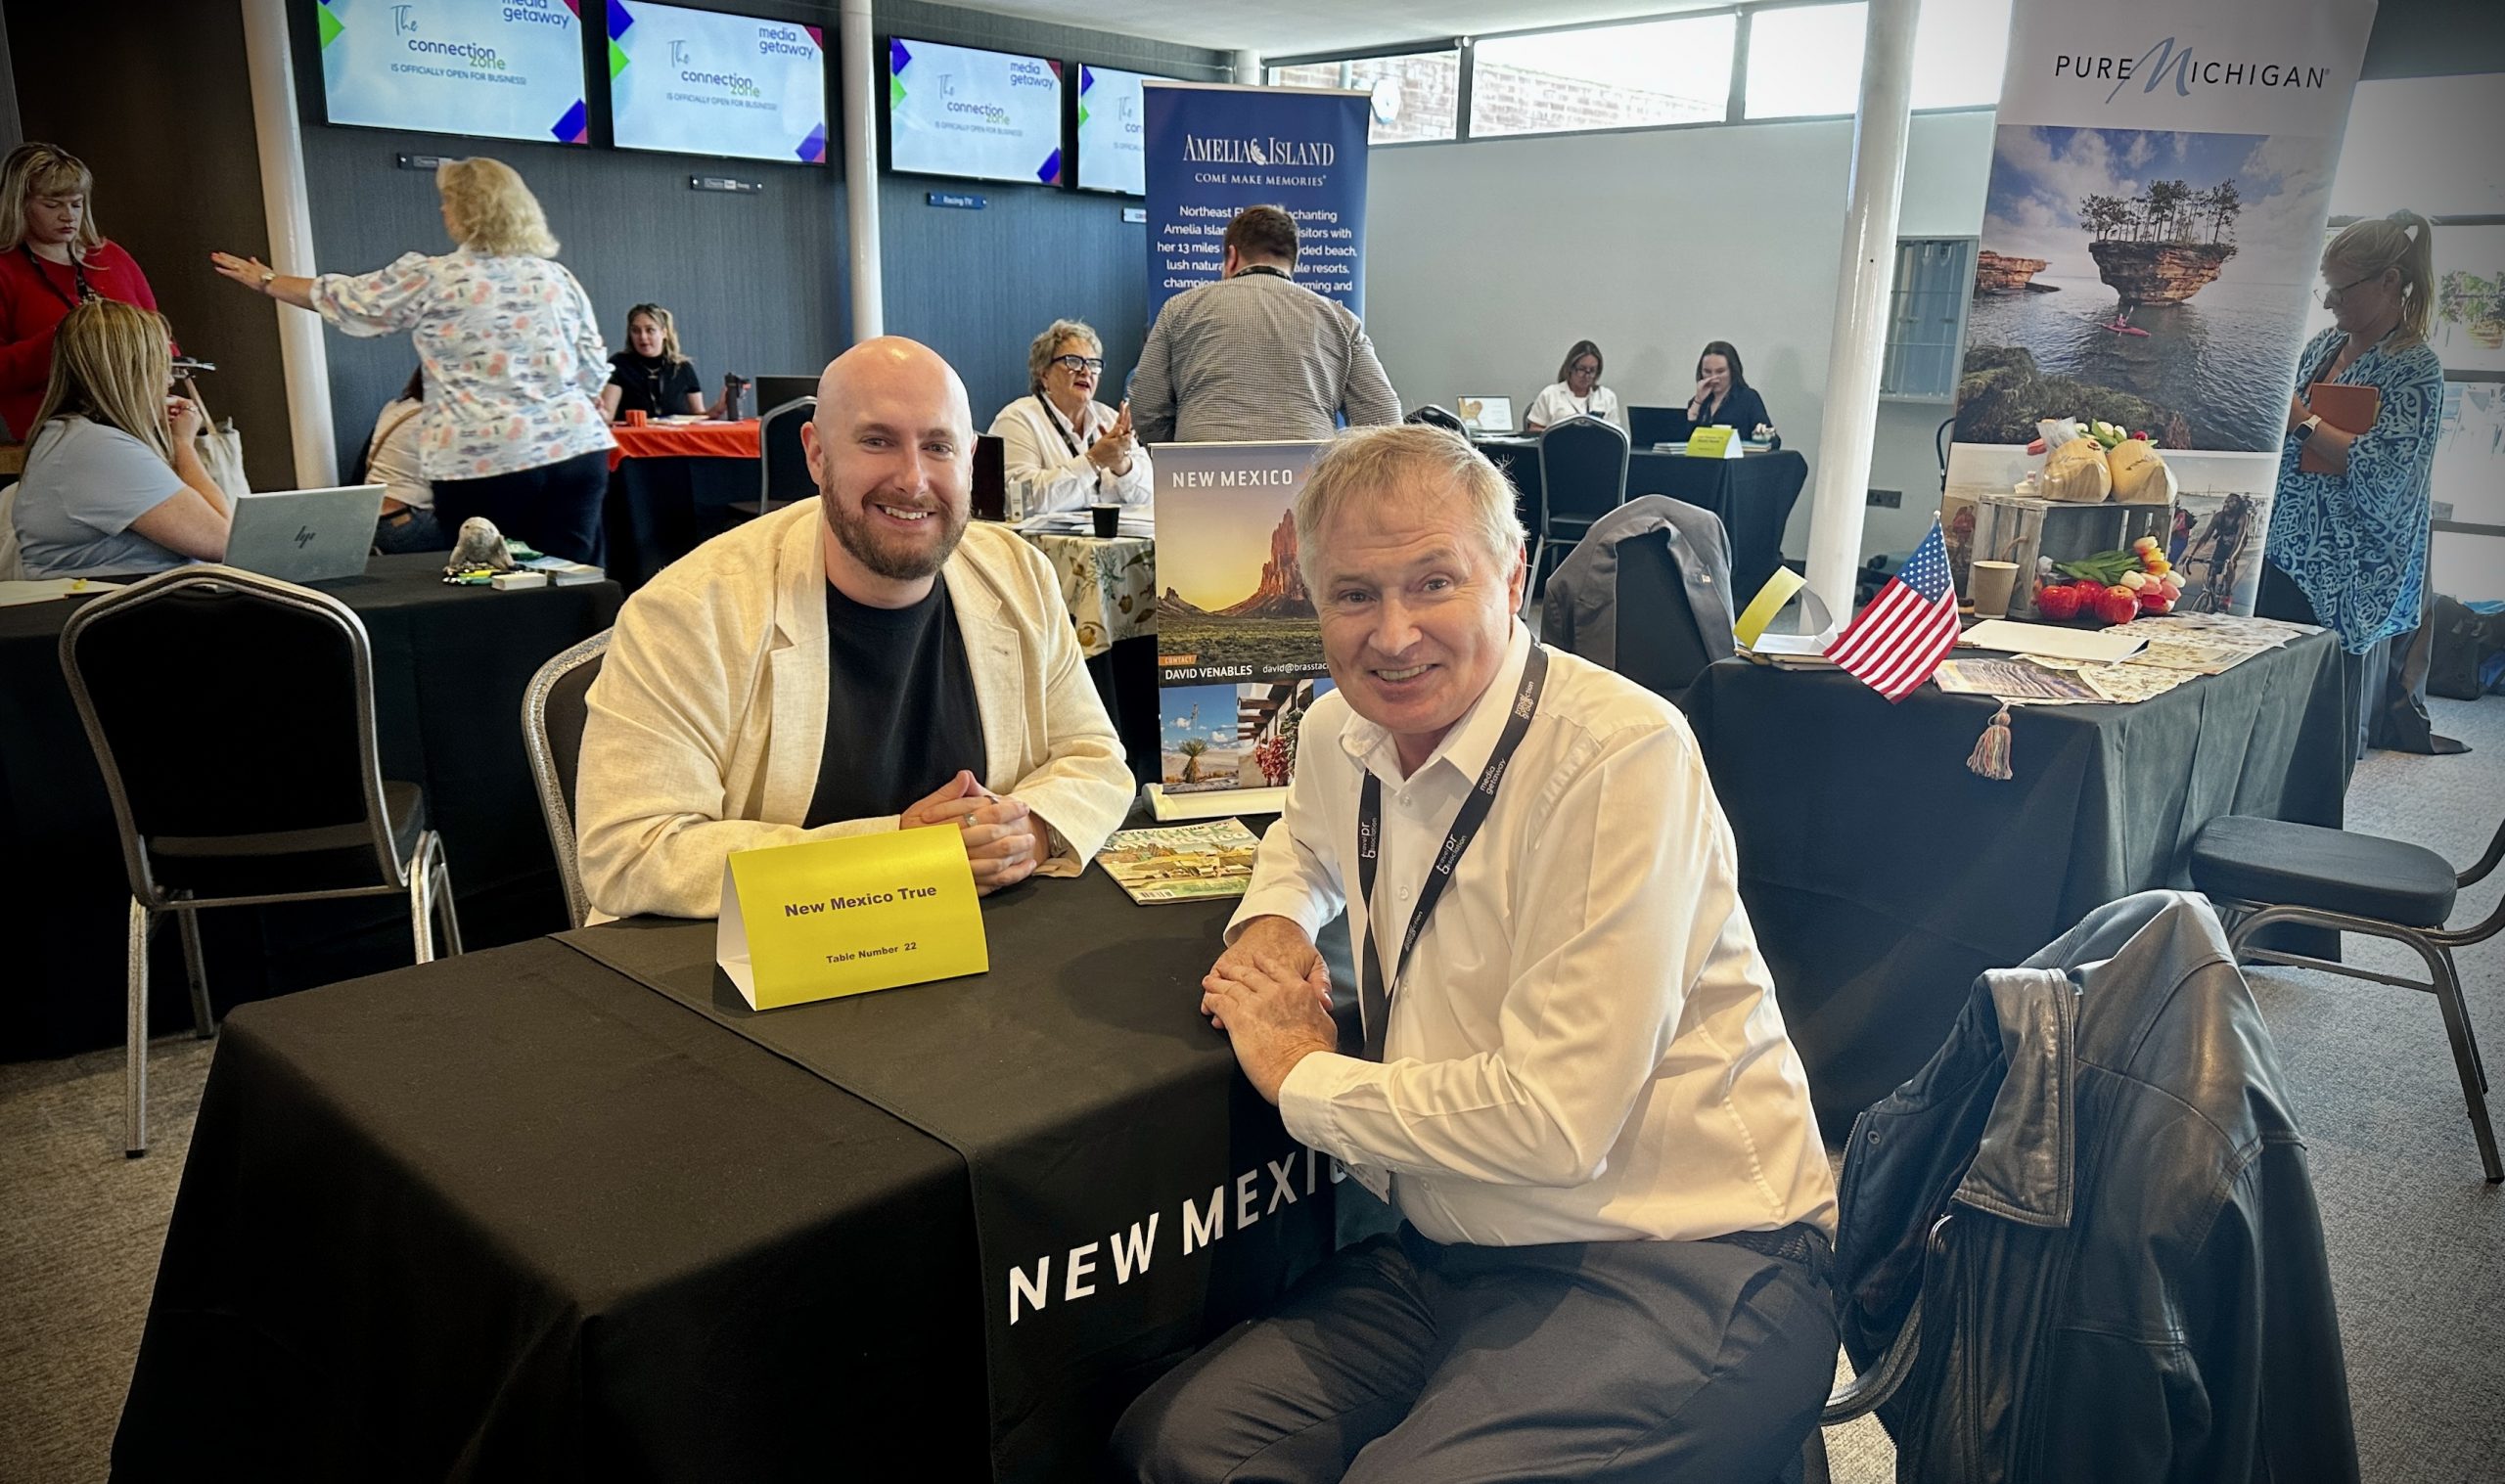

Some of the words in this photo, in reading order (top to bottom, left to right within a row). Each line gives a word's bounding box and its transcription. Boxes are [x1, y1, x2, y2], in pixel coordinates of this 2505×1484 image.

[391, 5, 419, 35] The
[503, 8, 569, 29] getaway
[758, 27, 797, 42] media
[408, 39, 496, 61] connection
[759, 40, 814, 60] getaway
[469, 57, 507, 69] zone
[1010, 62, 1040, 75] media
[2055, 55, 2133, 79] PURE
[2106, 37, 2325, 104] MICHIGAN
[400, 65, 444, 77] OFFICIALLY
[446, 69, 469, 79] OPEN
[471, 72, 486, 81] FOR
[681, 69, 752, 90] connection
[1010, 73, 1054, 91] getaway
[731, 86, 760, 99] zone
[946, 102, 1004, 117] connection
[1183, 134, 1252, 163] AMELIA
[1268, 137, 1334, 166] ISLAND
[1195, 173, 1226, 184] COME
[1231, 175, 1261, 185] MAKE
[1265, 176, 1323, 188] MEMORIES
[1179, 205, 1231, 219] Northeast
[1164, 224, 1200, 236] Amelia
[1204, 224, 1227, 236] Islan
[1297, 228, 1328, 239] isitors
[1330, 227, 1351, 239] with
[1157, 242, 1174, 253] her
[1177, 244, 1189, 257] 13
[1192, 243, 1220, 254] miles
[1166, 259, 1189, 271] lush
[1191, 260, 1225, 272] natura
[1294, 263, 1309, 274] ale
[1333, 281, 1352, 292] and
[1172, 472, 1214, 488] NEW
[1220, 470, 1293, 487] MEXICO
[1164, 656, 1193, 665] CONTACT
[1164, 667, 1197, 680] DAVID
[1200, 665, 1252, 679] VENABLES
[1262, 662, 1328, 675] david@brasstac
[1480, 765, 1495, 791] media
[1486, 758, 1506, 795] getaway
[1361, 822, 1370, 836] pr
[1446, 833, 1457, 852] pr
[785, 902, 825, 917] New
[830, 893, 893, 910] Mexico
[897, 886, 937, 900] True
[826, 953, 855, 964] Table
[858, 946, 898, 959] Number
[904, 942, 917, 952] 22
[1010, 1212, 1160, 1326] NEW
[1183, 1147, 1345, 1256] MEXI
